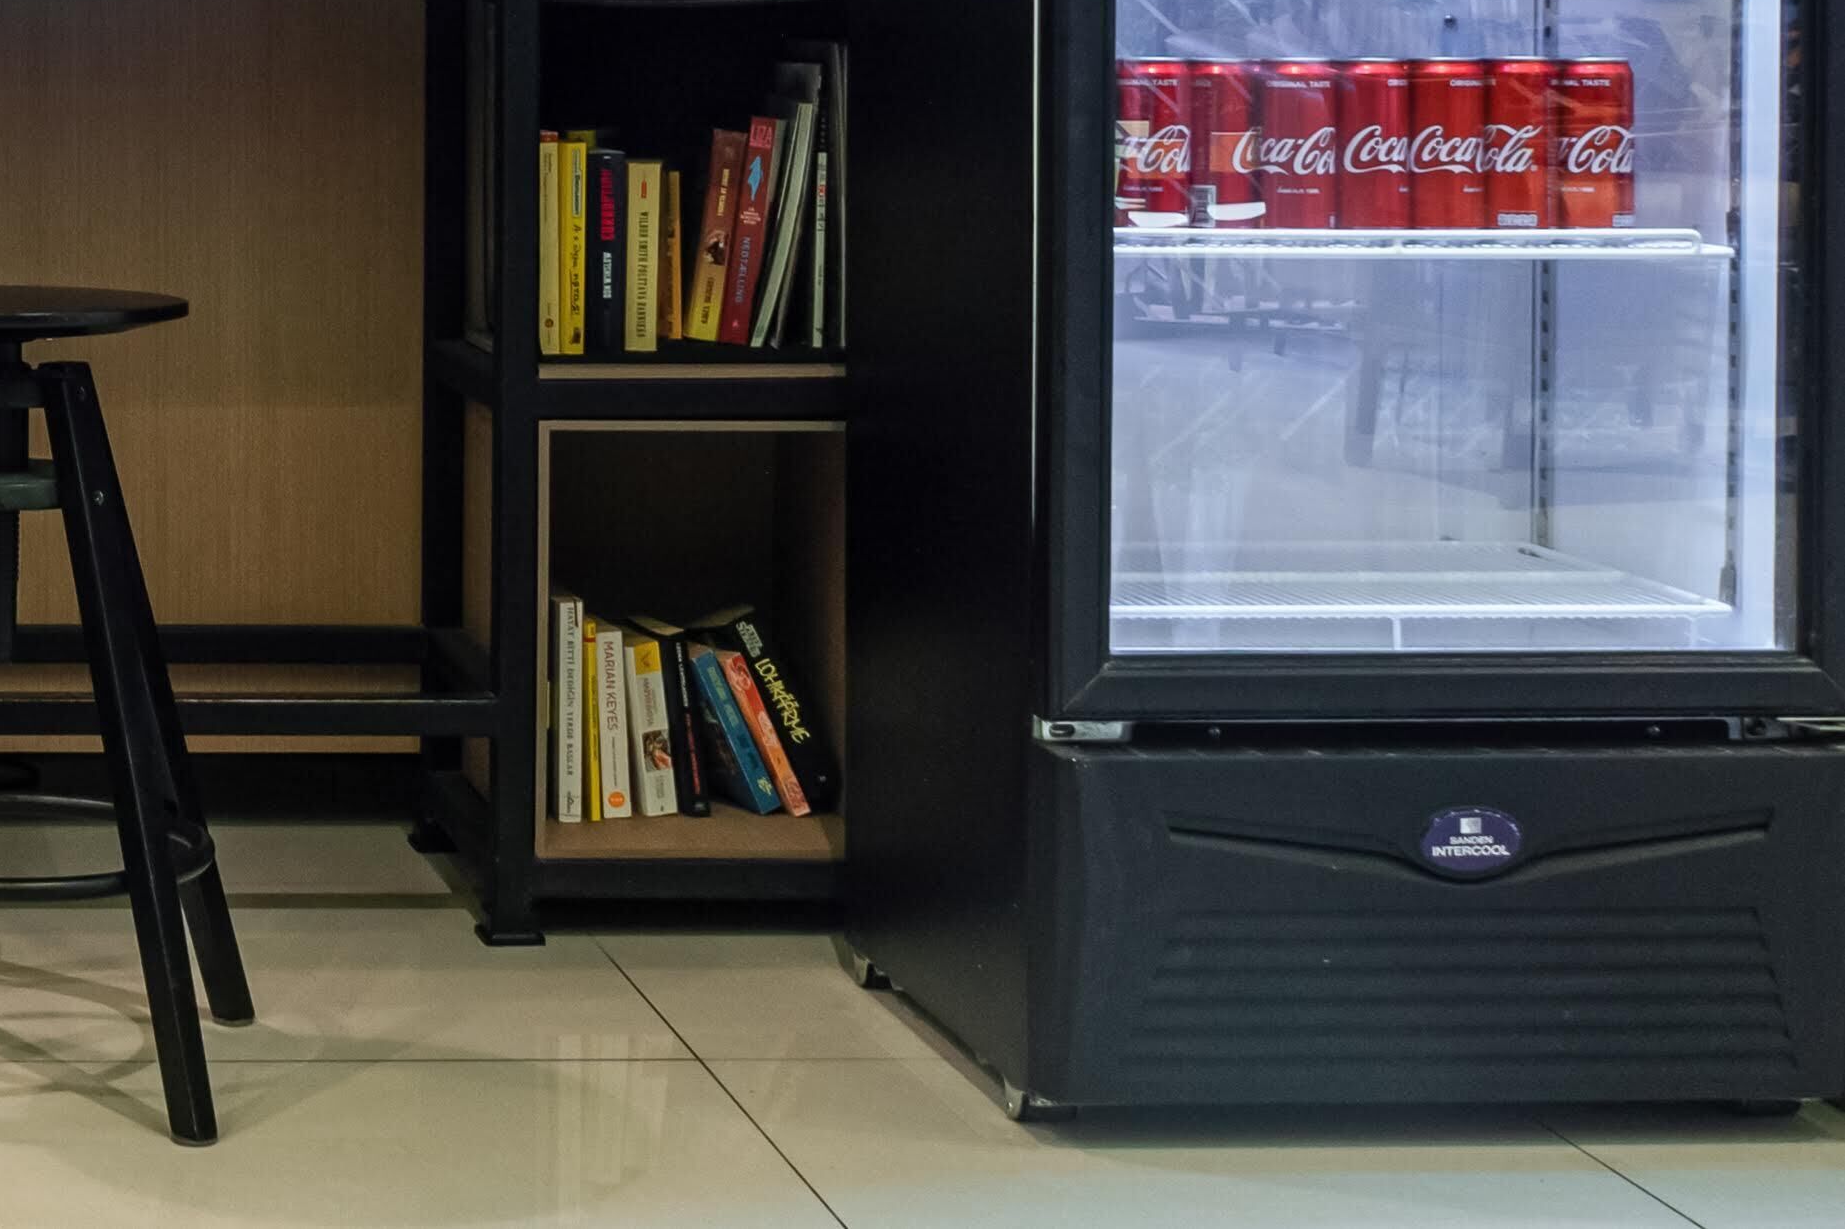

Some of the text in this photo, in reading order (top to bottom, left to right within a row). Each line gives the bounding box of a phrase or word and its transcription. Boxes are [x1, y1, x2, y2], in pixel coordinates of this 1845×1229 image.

[603, 641, 617, 689] MARIAN
[605, 691, 618, 731] KEYES
[1432, 844, 1511, 857] INTERCOOL
[1449, 835, 1494, 845] SANDEN
